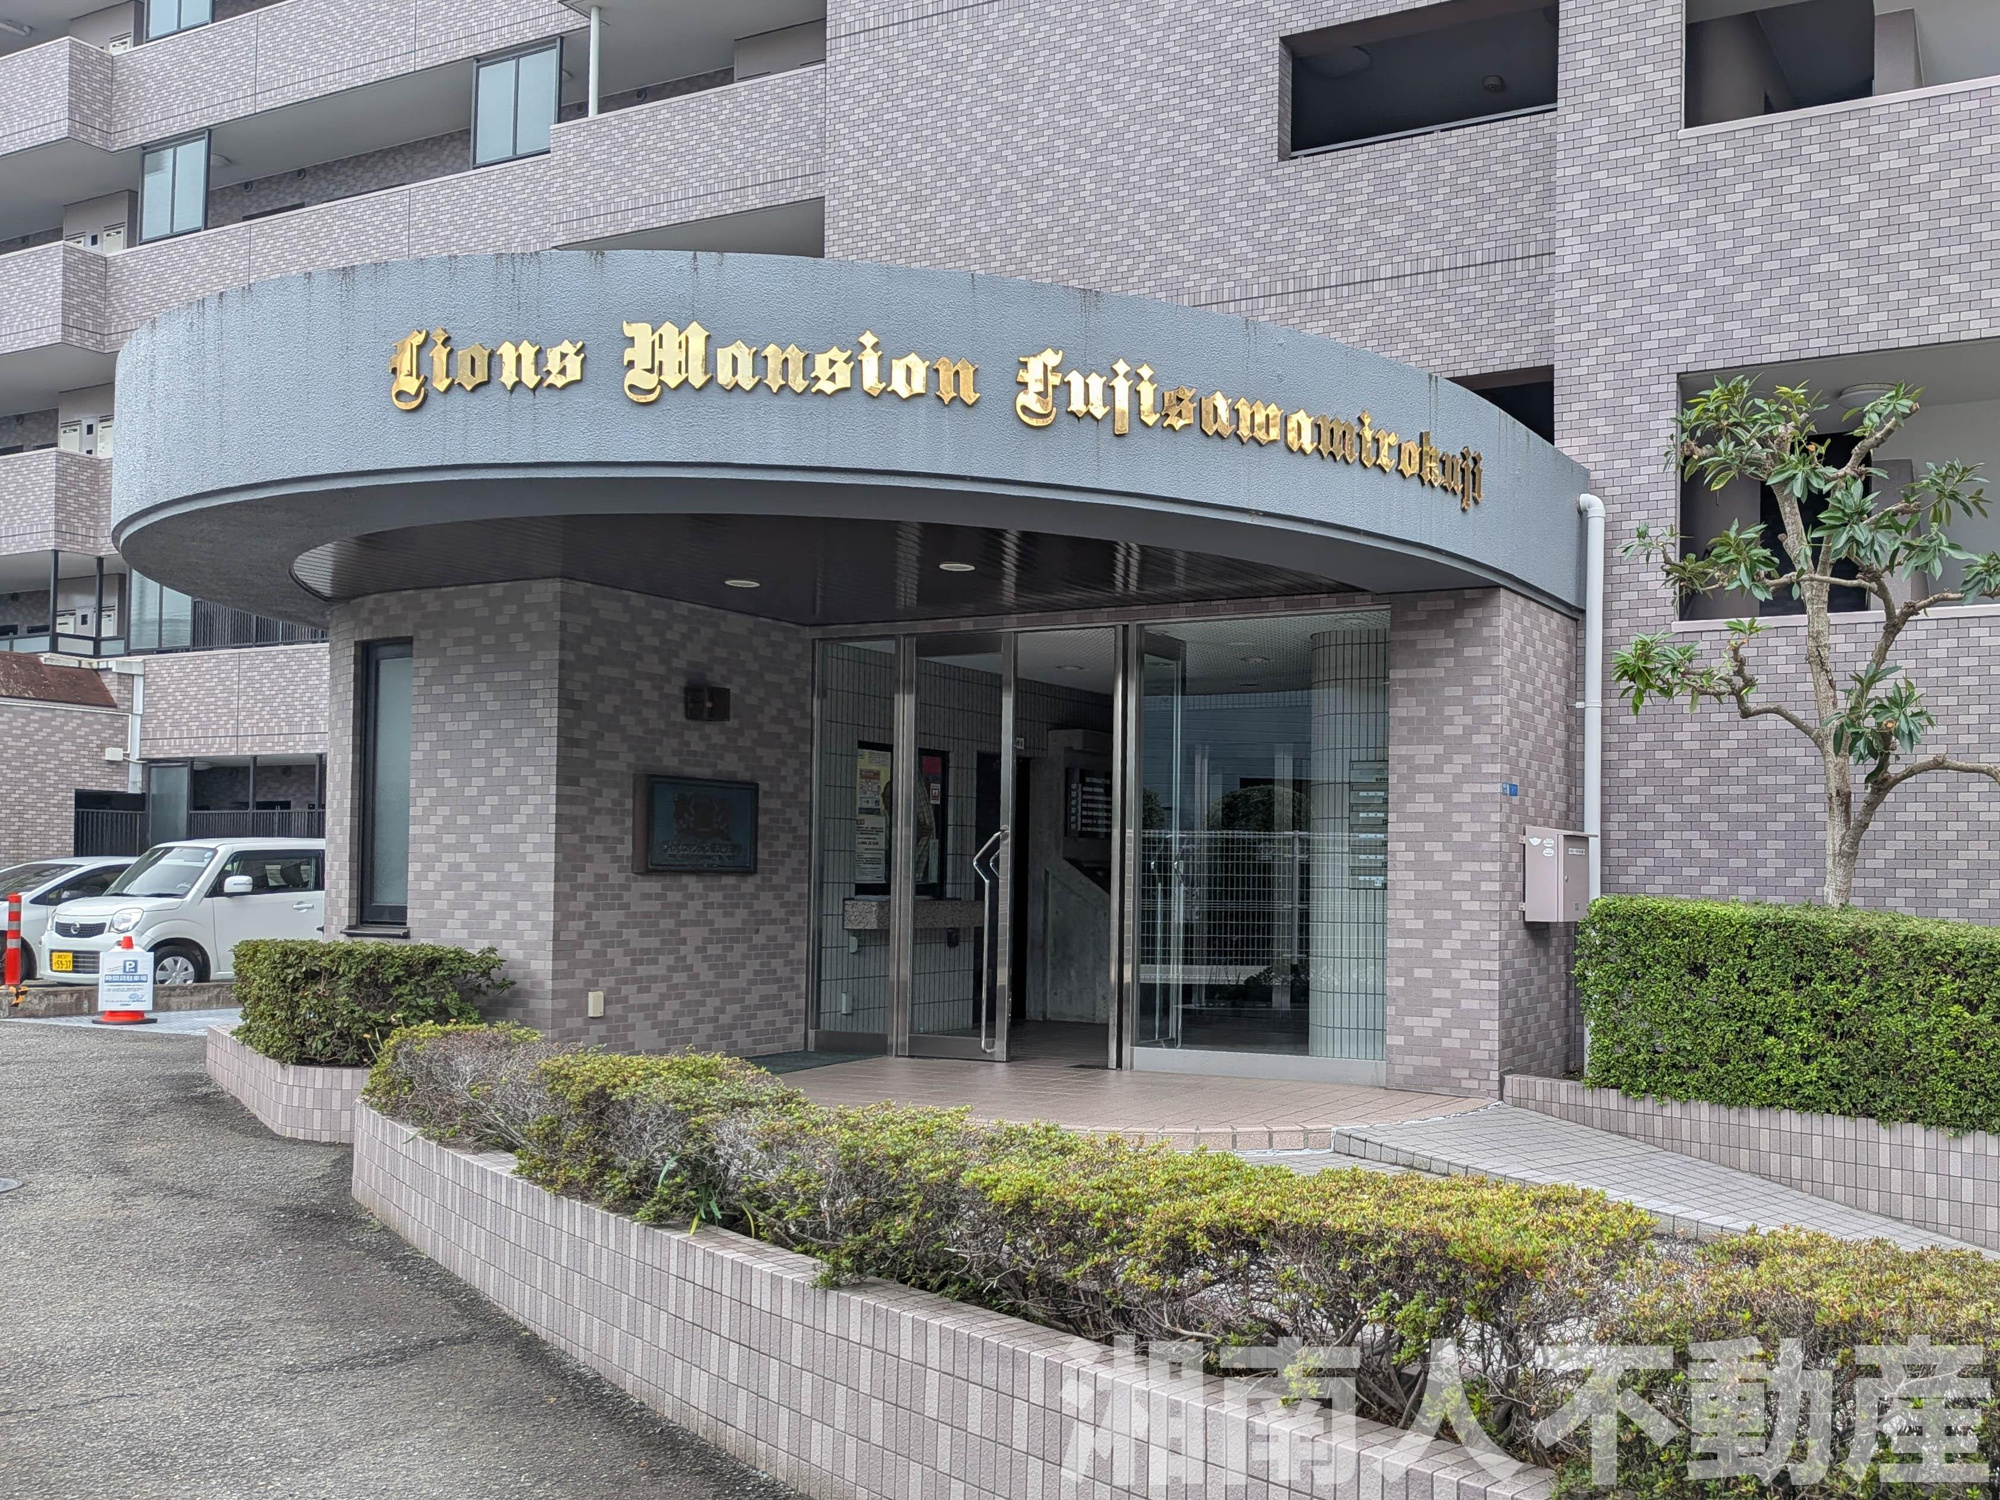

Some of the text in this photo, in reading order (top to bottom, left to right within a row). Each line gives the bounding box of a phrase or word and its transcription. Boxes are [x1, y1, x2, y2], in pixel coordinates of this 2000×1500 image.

[387, 320, 1485, 511] Lions Mansion Fujisawamirokuji
[125, 961, 136, 972] P
